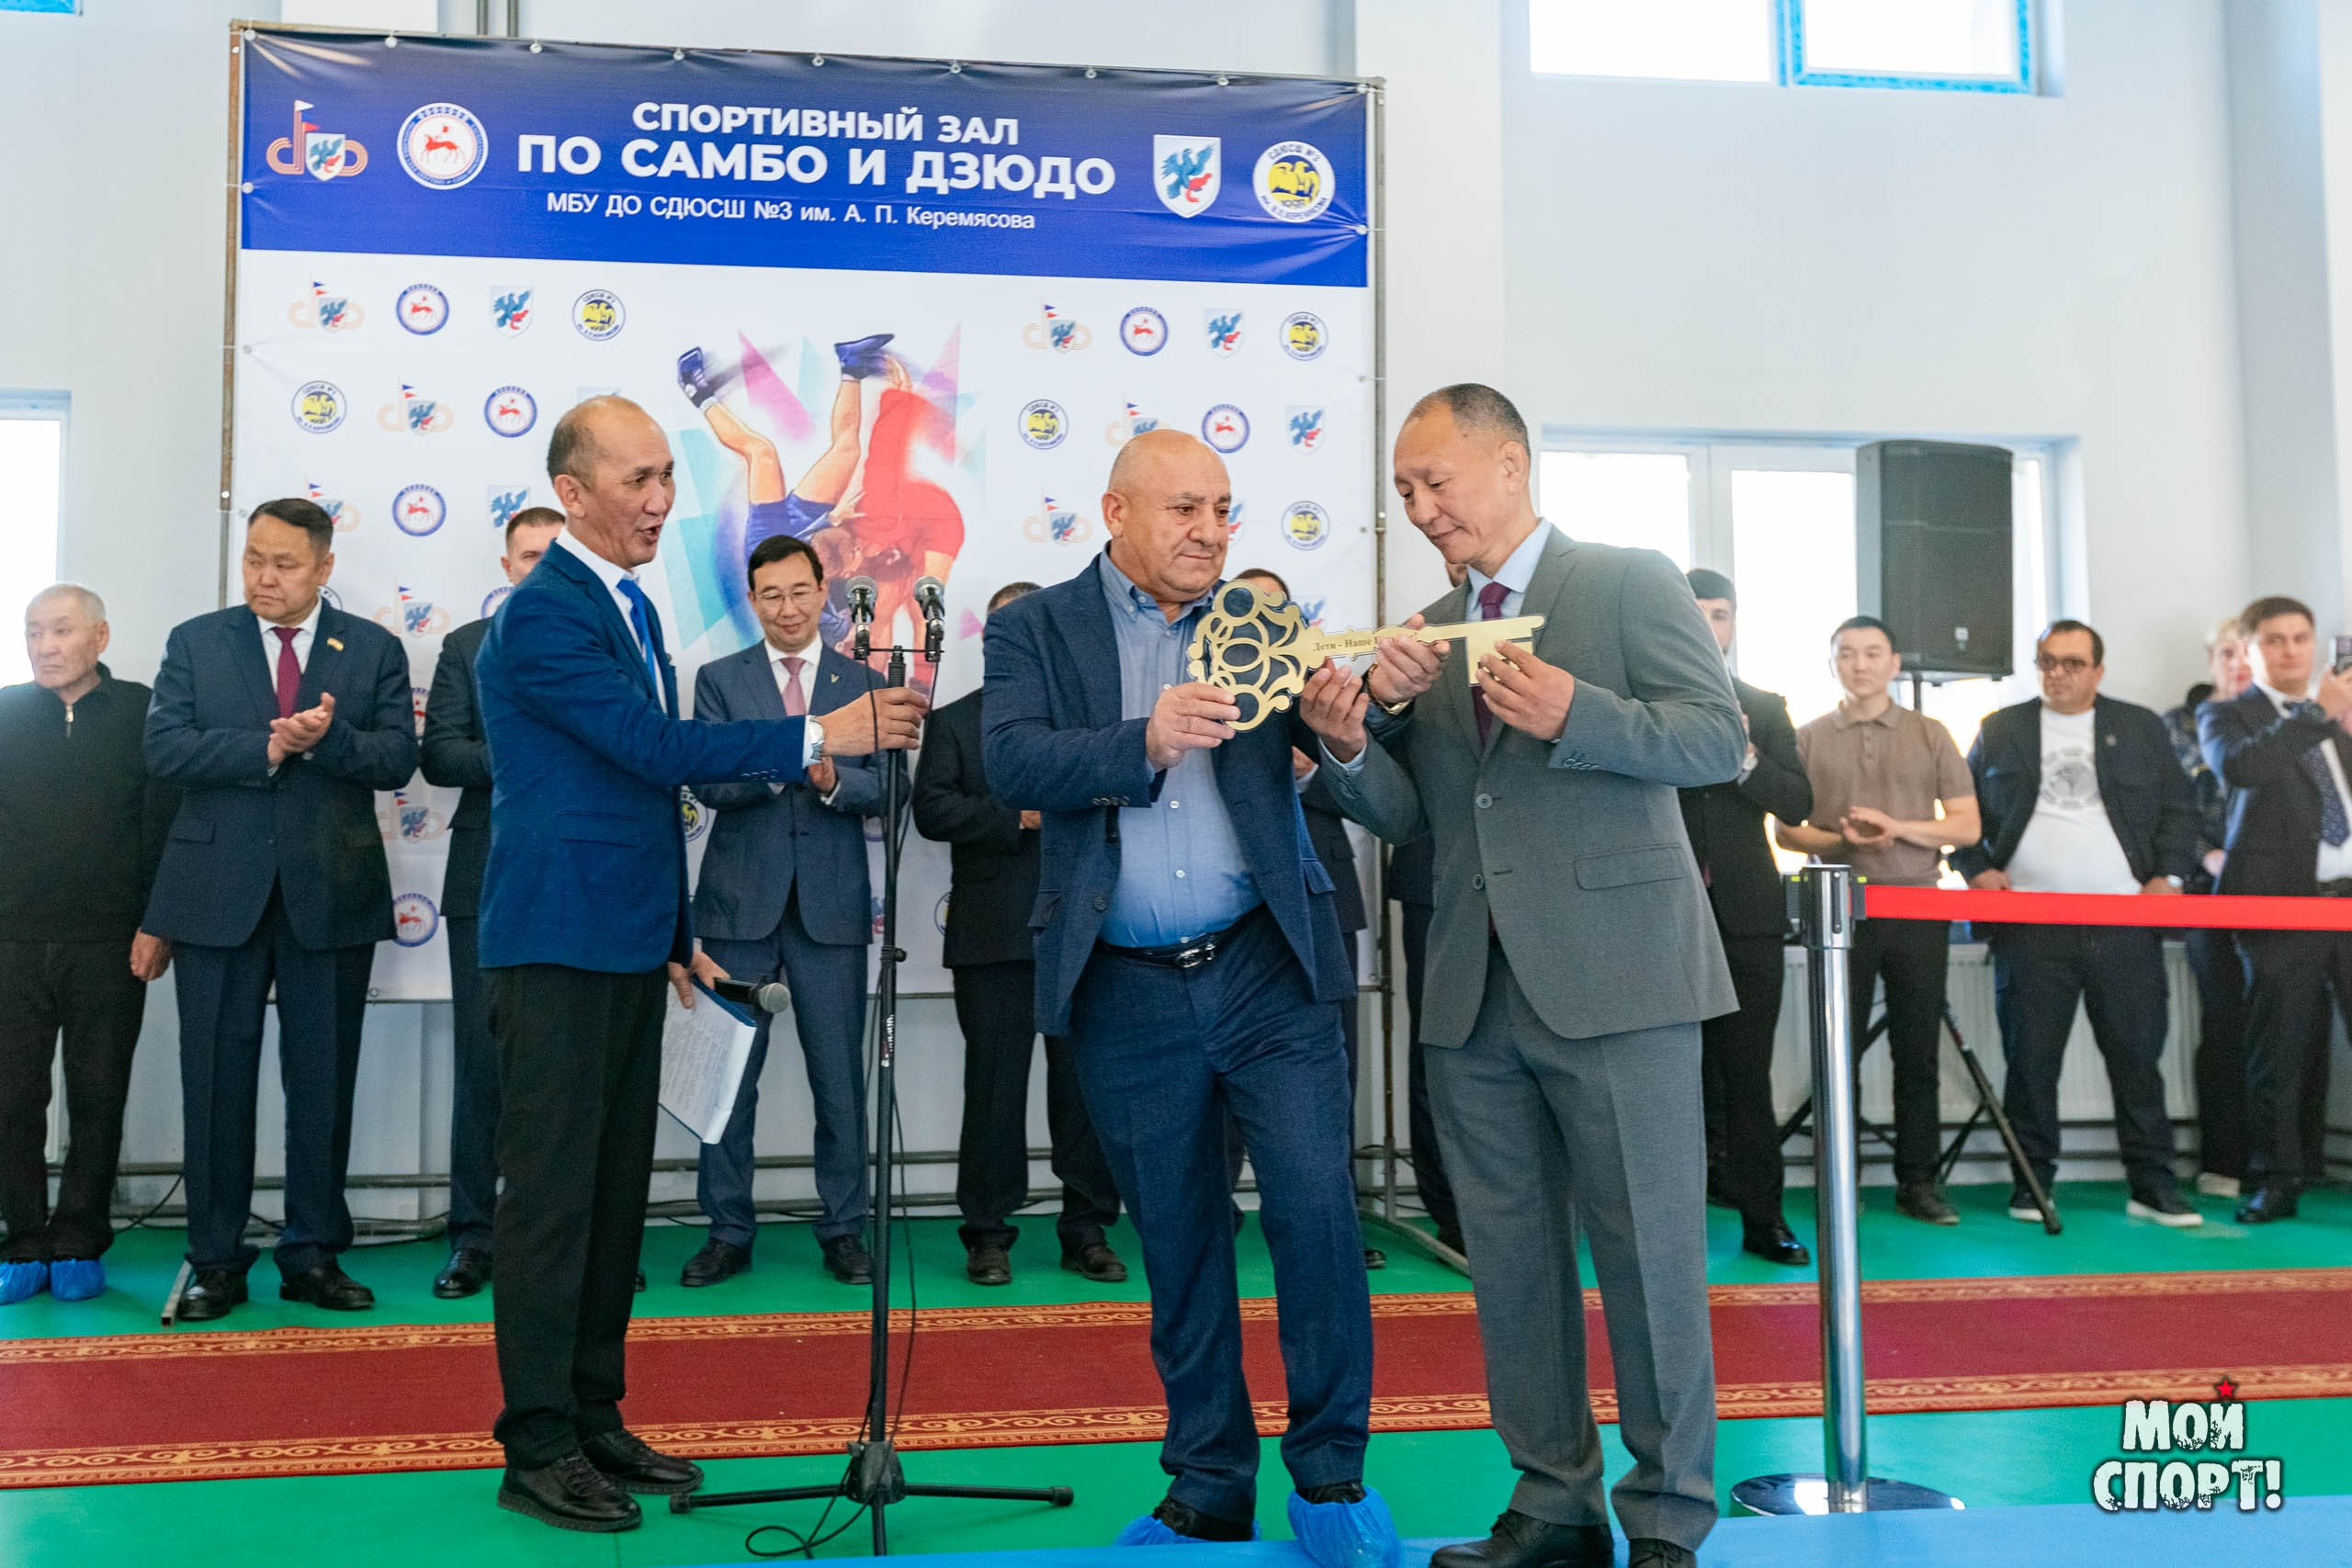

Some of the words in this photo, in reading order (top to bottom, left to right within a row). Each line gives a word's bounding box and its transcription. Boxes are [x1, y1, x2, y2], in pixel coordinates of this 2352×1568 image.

[632, 102, 923, 141] СПОРТИВНЫЙ
[937, 115, 1019, 145] ЗАЛ
[518, 134, 602, 175] ПО
[620, 138, 828, 184] САМБО
[848, 148, 887, 186] И
[905, 151, 1116, 199] ДЗЮДО
[547, 192, 599, 213] МБУ
[605, 195, 642, 218] ДО
[650, 196, 745, 220] СДЮСШ
[753, 200, 793, 220] №3
[800, 207, 836, 221] им.
[843, 203, 866, 223] А.
[875, 205, 899, 224] П.
[907, 206, 1035, 230] Керемясова
